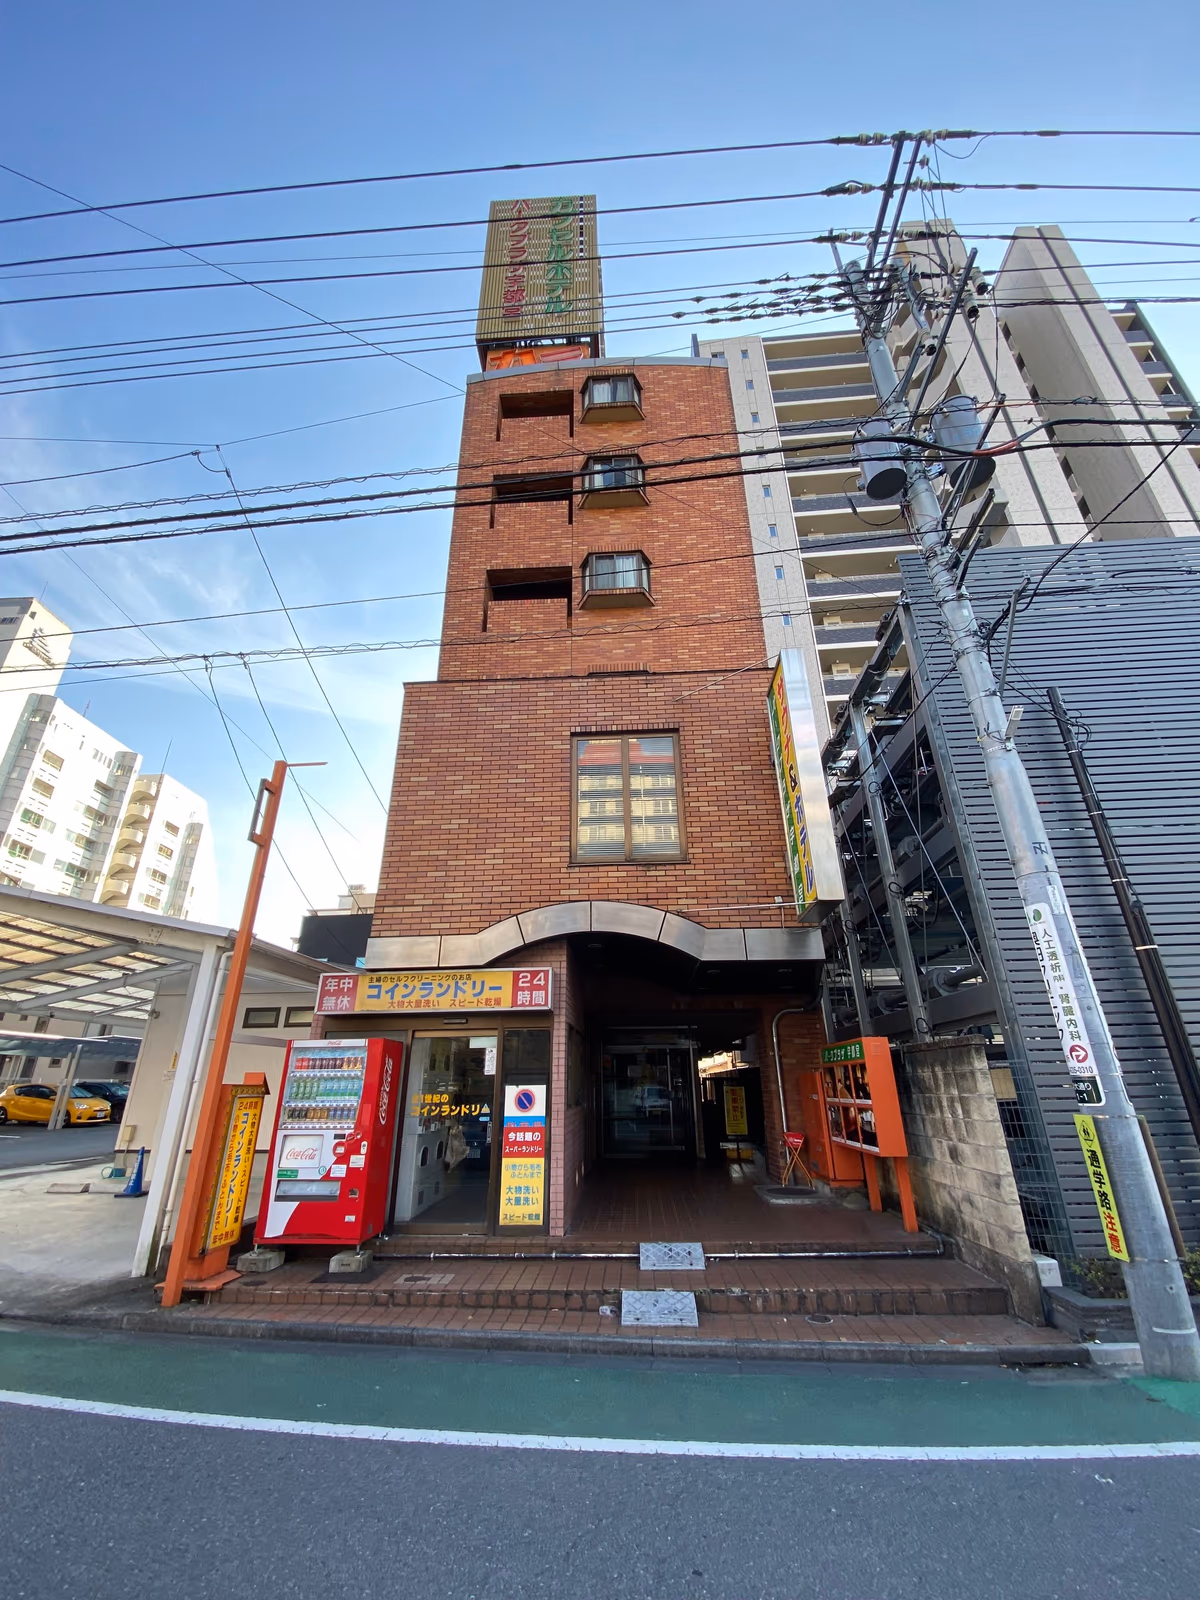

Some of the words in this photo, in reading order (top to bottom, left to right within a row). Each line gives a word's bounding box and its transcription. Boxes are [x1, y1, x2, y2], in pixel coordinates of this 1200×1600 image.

[324, 977, 354, 992] 年中
[368, 973, 472, 983] 主婦のセルフクリーニングのお店
[518, 973, 546, 987] 24
[366, 981, 503, 1000] コインランドリー
[321, 995, 352, 1010] 無休
[387, 998, 441, 1009] 大物大量洗い
[449, 997, 503, 1008] スピード乾燥
[517, 991, 546, 1005] 時間
[507, 1132, 541, 1142] 今話題の
[505, 1145, 543, 1153] スーパーランドリー
[505, 1185, 540, 1195] 大物洗い
[505, 1196, 540, 1206] 大量洗い
[1086, 1148, 1124, 1255] 通学路注意
